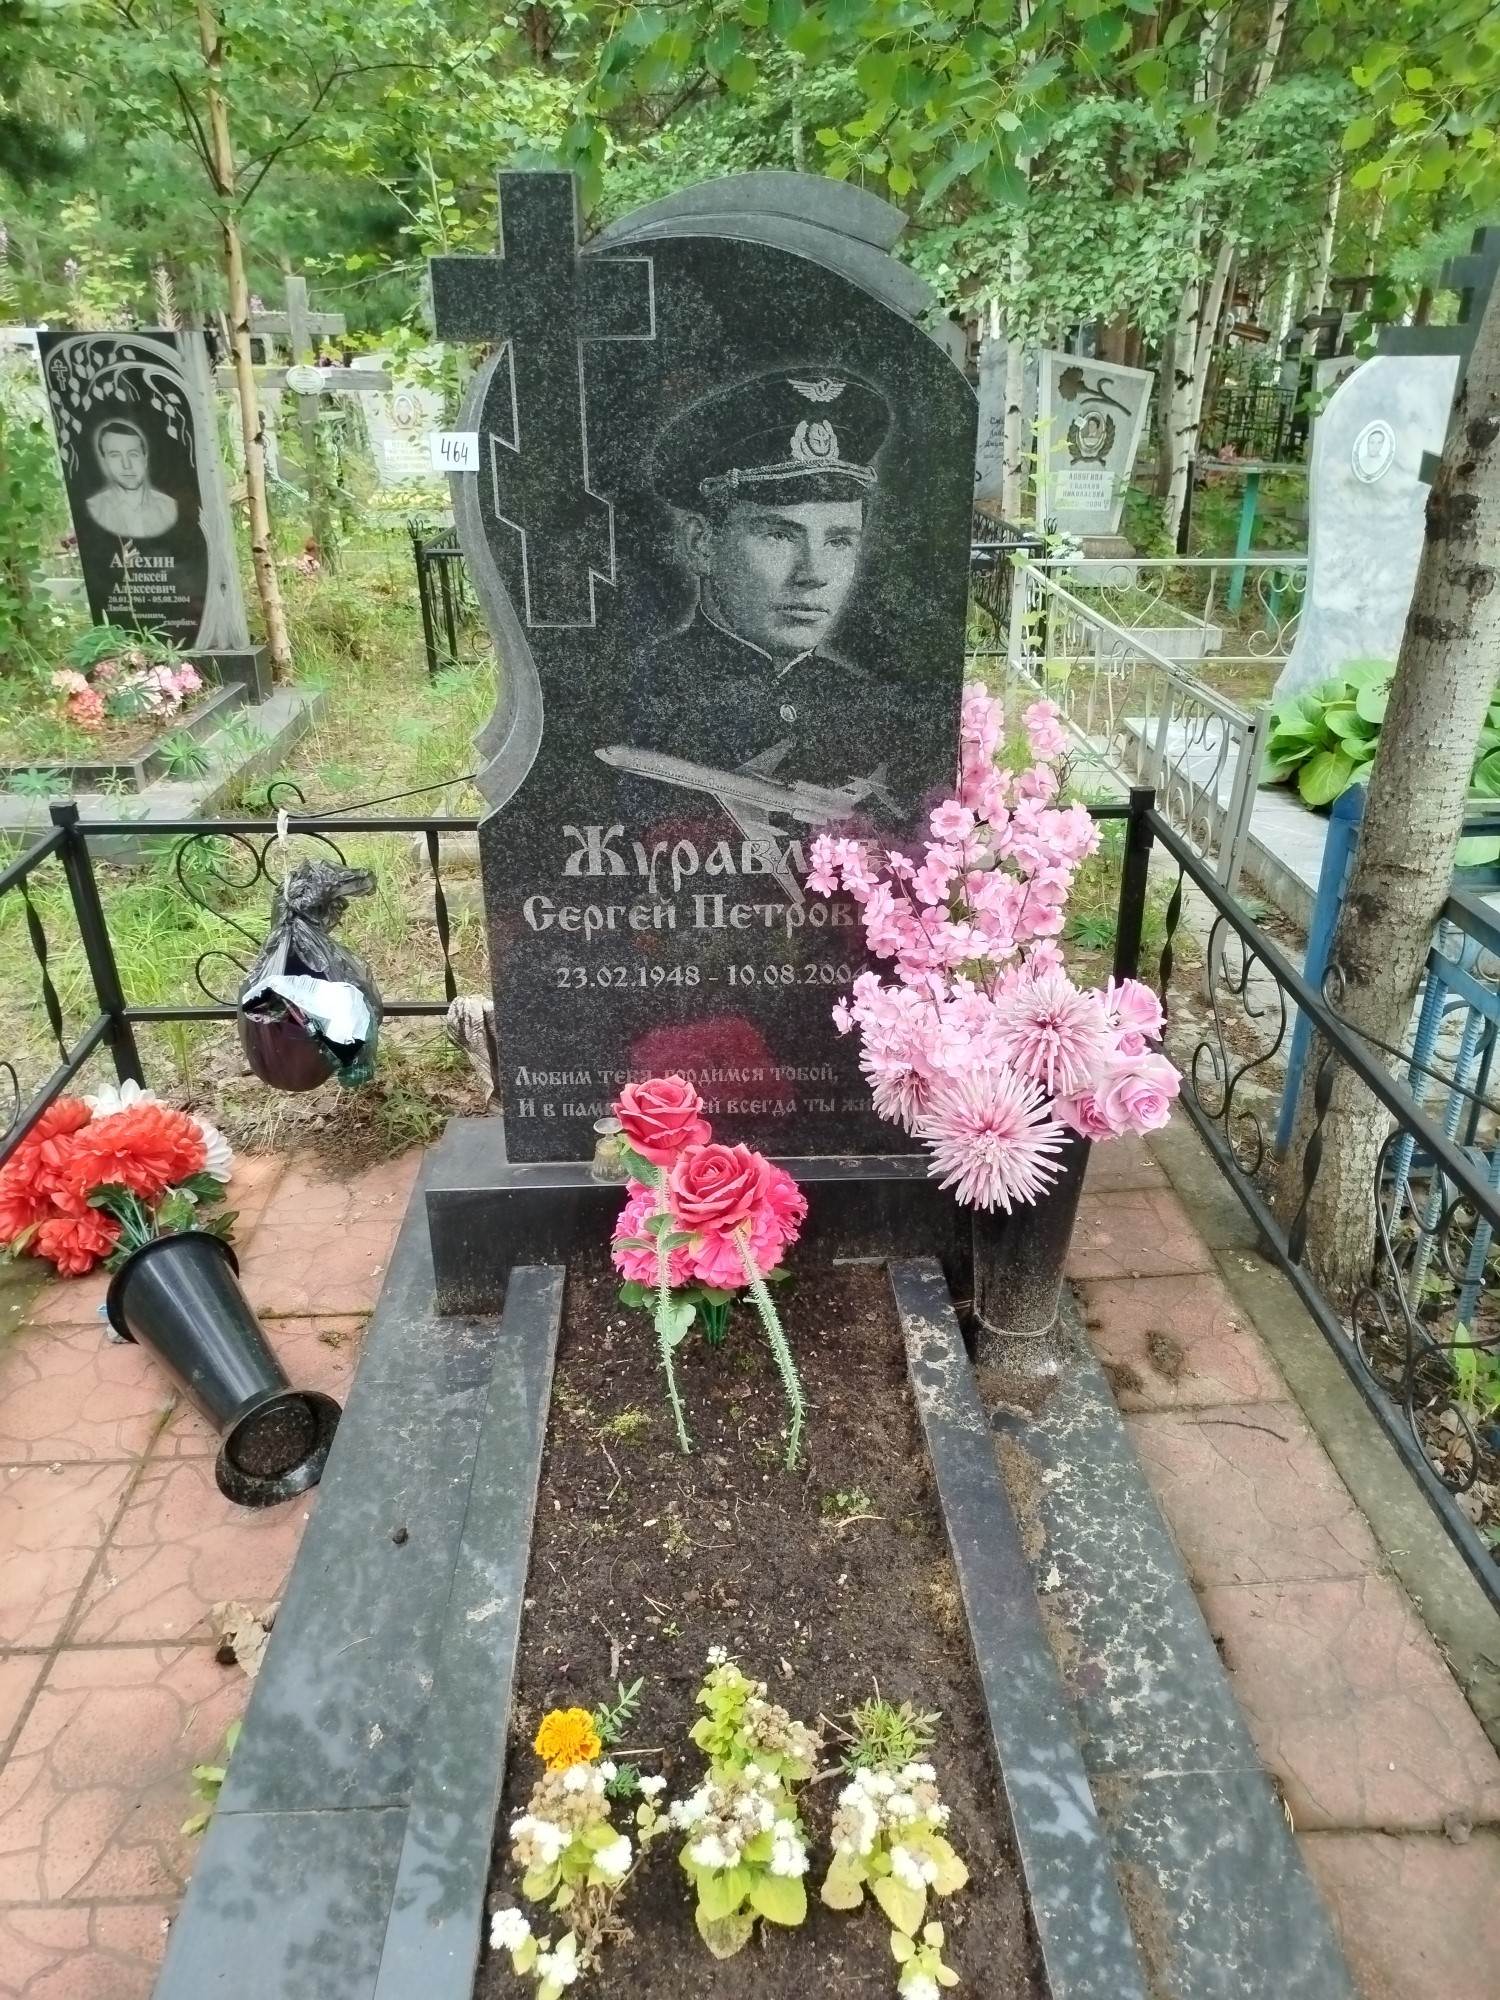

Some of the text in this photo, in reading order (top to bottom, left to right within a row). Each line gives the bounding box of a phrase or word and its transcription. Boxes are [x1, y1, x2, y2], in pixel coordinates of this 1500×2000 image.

[441, 438, 469, 465] 464
[113, 582, 176, 594] Алексеевич
[123, 570, 168, 582] Алексей
[523, 893, 864, 941] Сергей Петров
[556, 965, 701, 988] 23.02.1948
[727, 963, 869, 985] 10.08.2004
[515, 1066, 592, 1086] Любим
[769, 1062, 839, 1084] тобой,
[519, 1098, 537, 1118] И
[541, 1102, 555, 1117] в
[727, 1099, 798, 1116] всегда
[803, 1098, 836, 1112] ты
[842, 1098, 874, 1113] жи
